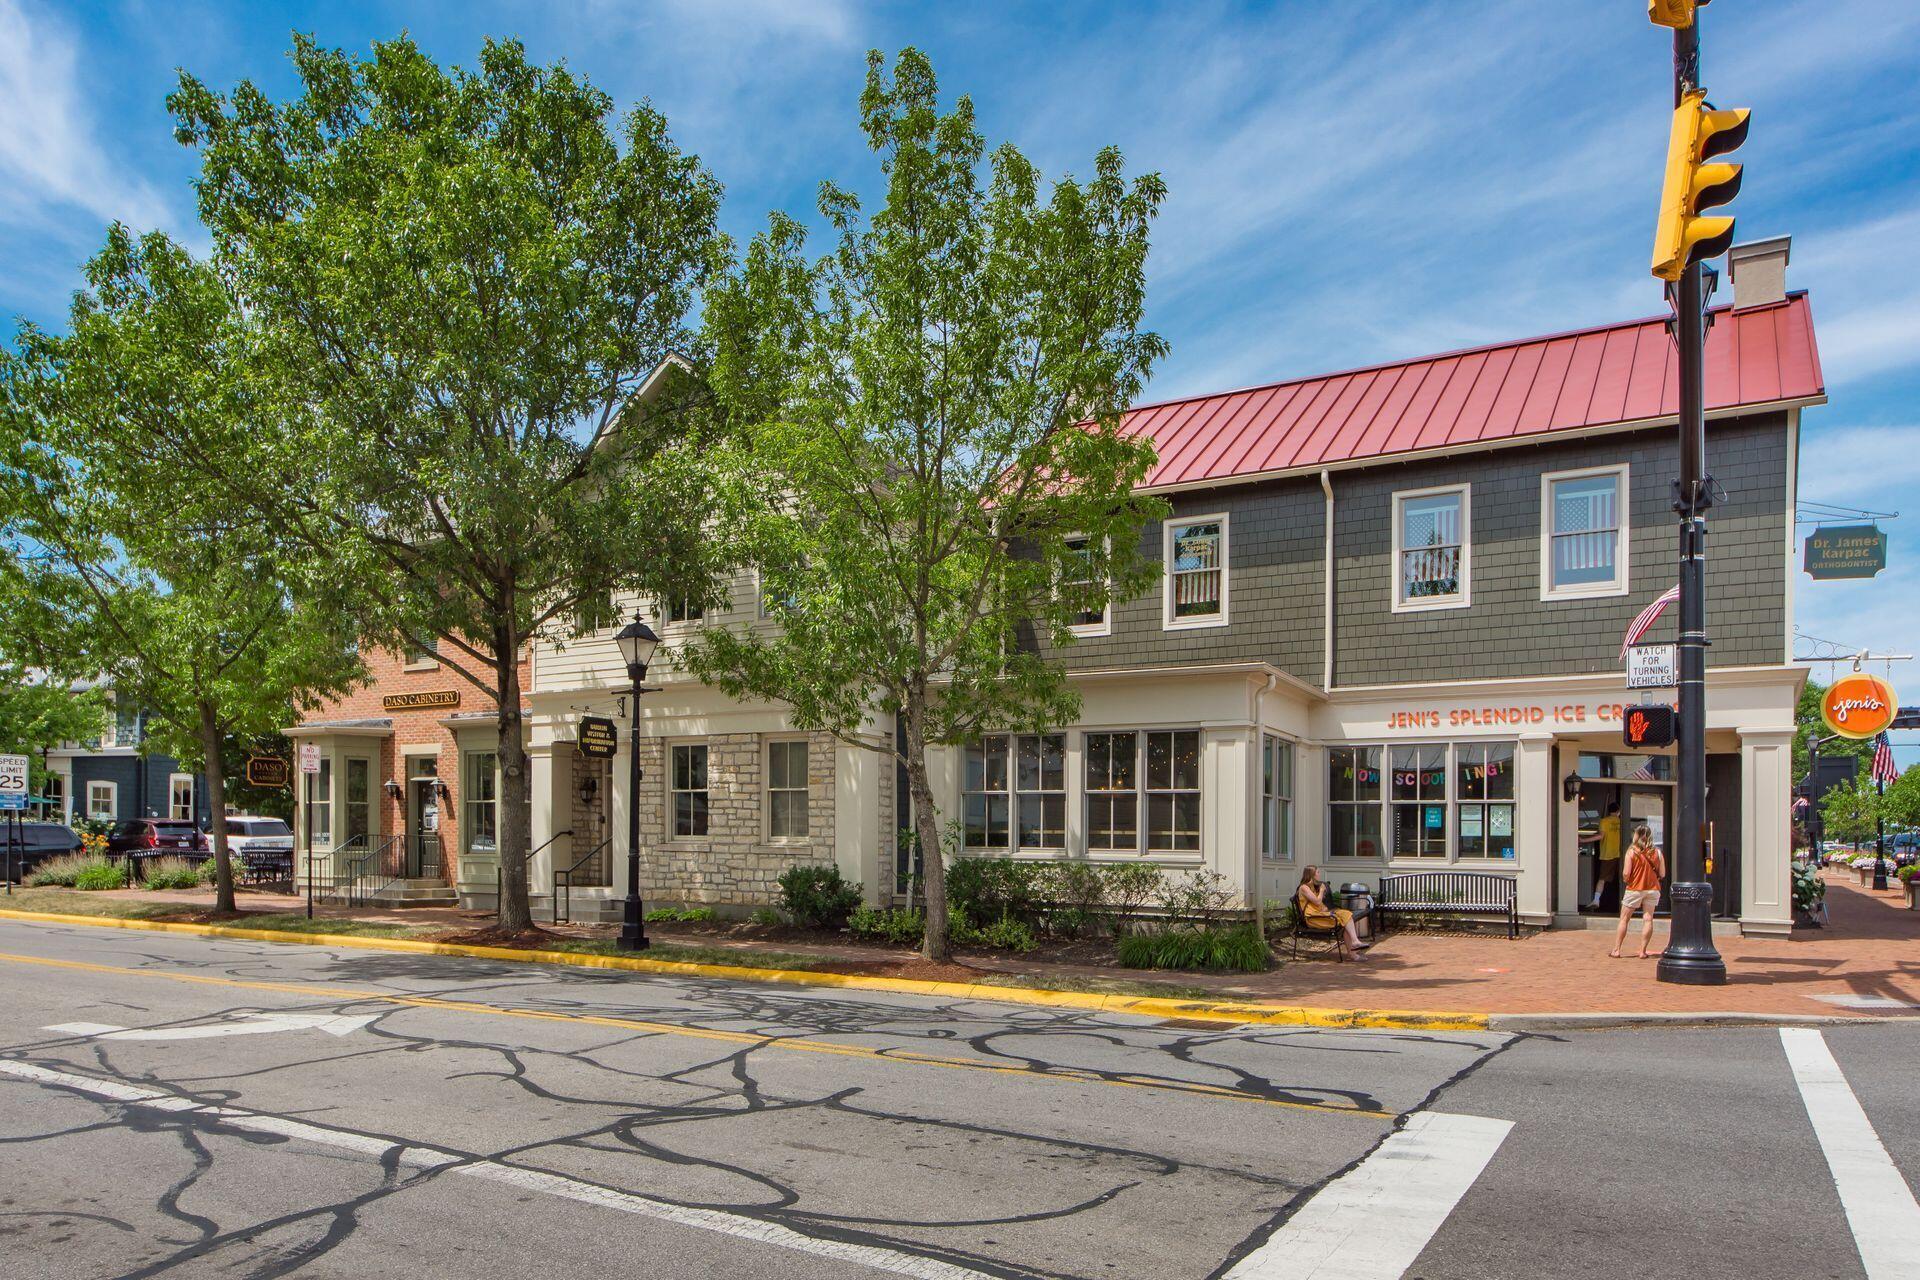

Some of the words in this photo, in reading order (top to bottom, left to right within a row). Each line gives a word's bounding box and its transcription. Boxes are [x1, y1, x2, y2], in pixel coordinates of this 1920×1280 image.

[1814, 539, 1831, 549] Dr.
[1836, 537, 1879, 548] James
[1822, 549, 1870, 559] Karpac
[1812, 560, 1879, 569] ORTHODONTIST
[1636, 647, 1667, 656] WATCH
[1642, 657, 1659, 665] FOR
[1633, 666, 1669, 676] TURNING
[1631, 676, 1672, 686] VEHICLES
[385, 695, 408, 706] DASO
[409, 692, 455, 705] CABINETRY
[1388, 711, 1440, 728] JENI'S
[1450, 706, 1544, 727] SPLENDID
[1554, 705, 1586, 723] ICE
[254, 762, 283, 771] DASO
[1344, 767, 1379, 783] NOW
[0, 775, 24, 789] 25
